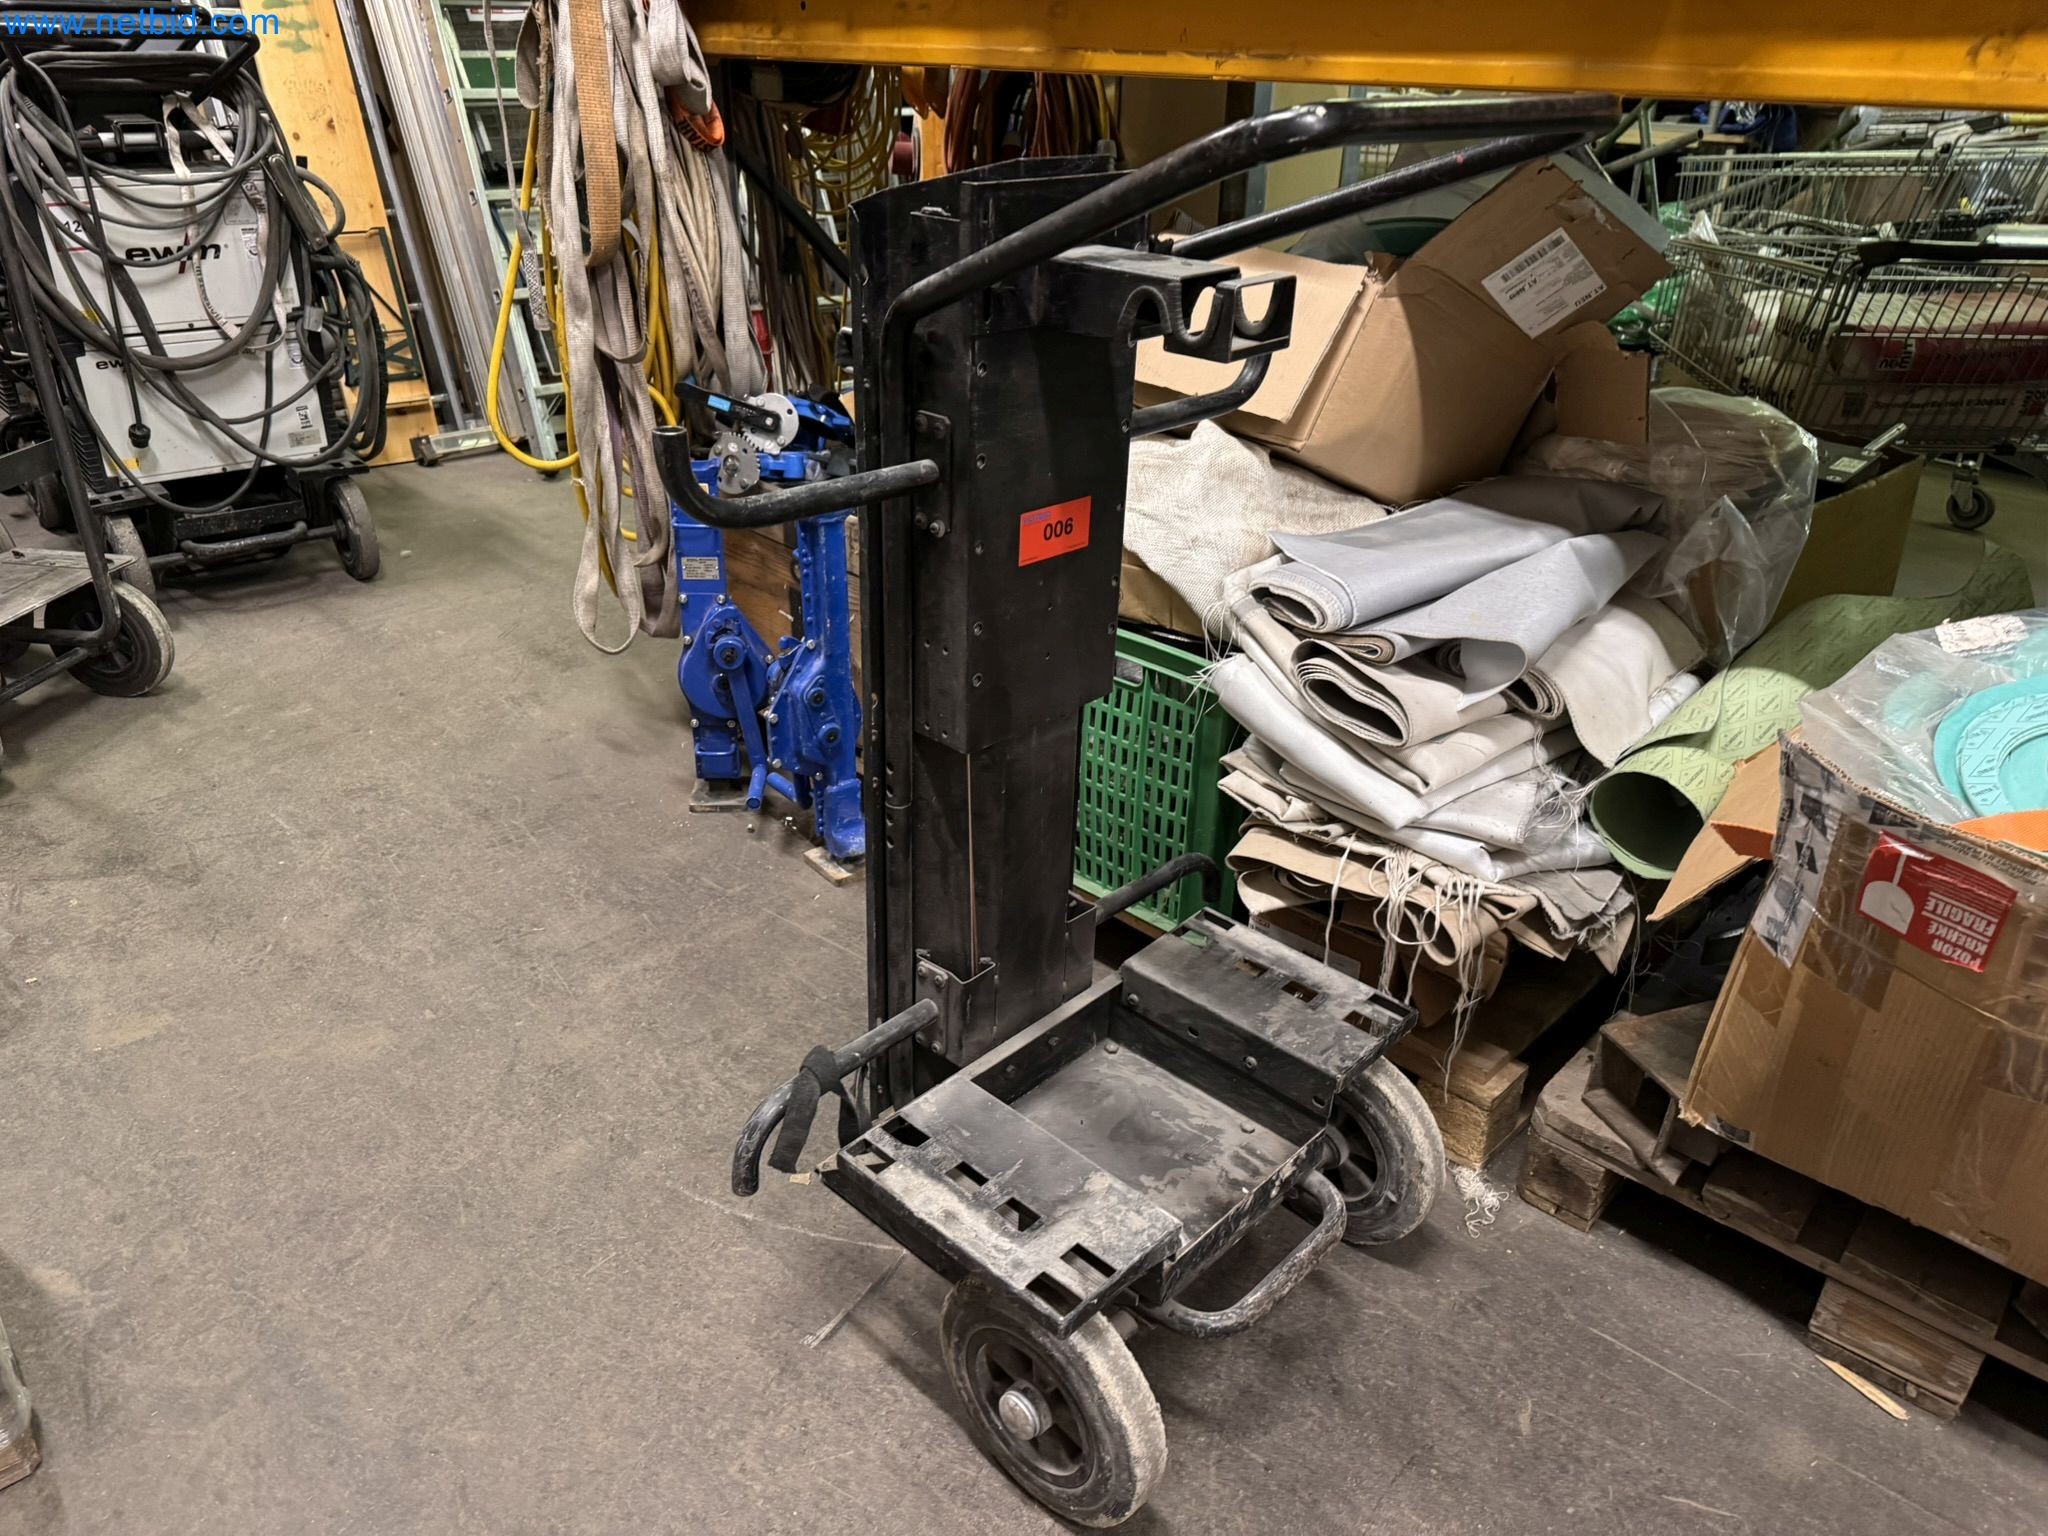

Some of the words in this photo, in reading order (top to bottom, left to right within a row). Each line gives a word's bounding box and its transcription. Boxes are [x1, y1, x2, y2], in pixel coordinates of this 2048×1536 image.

[96, 359, 124, 370] ew
[1043, 517, 1074, 541] 006
[1925, 897, 1998, 937] FRAGILE
[1927, 920, 1988, 956] KREHKÉ
[1931, 936, 1982, 973] POZOR
